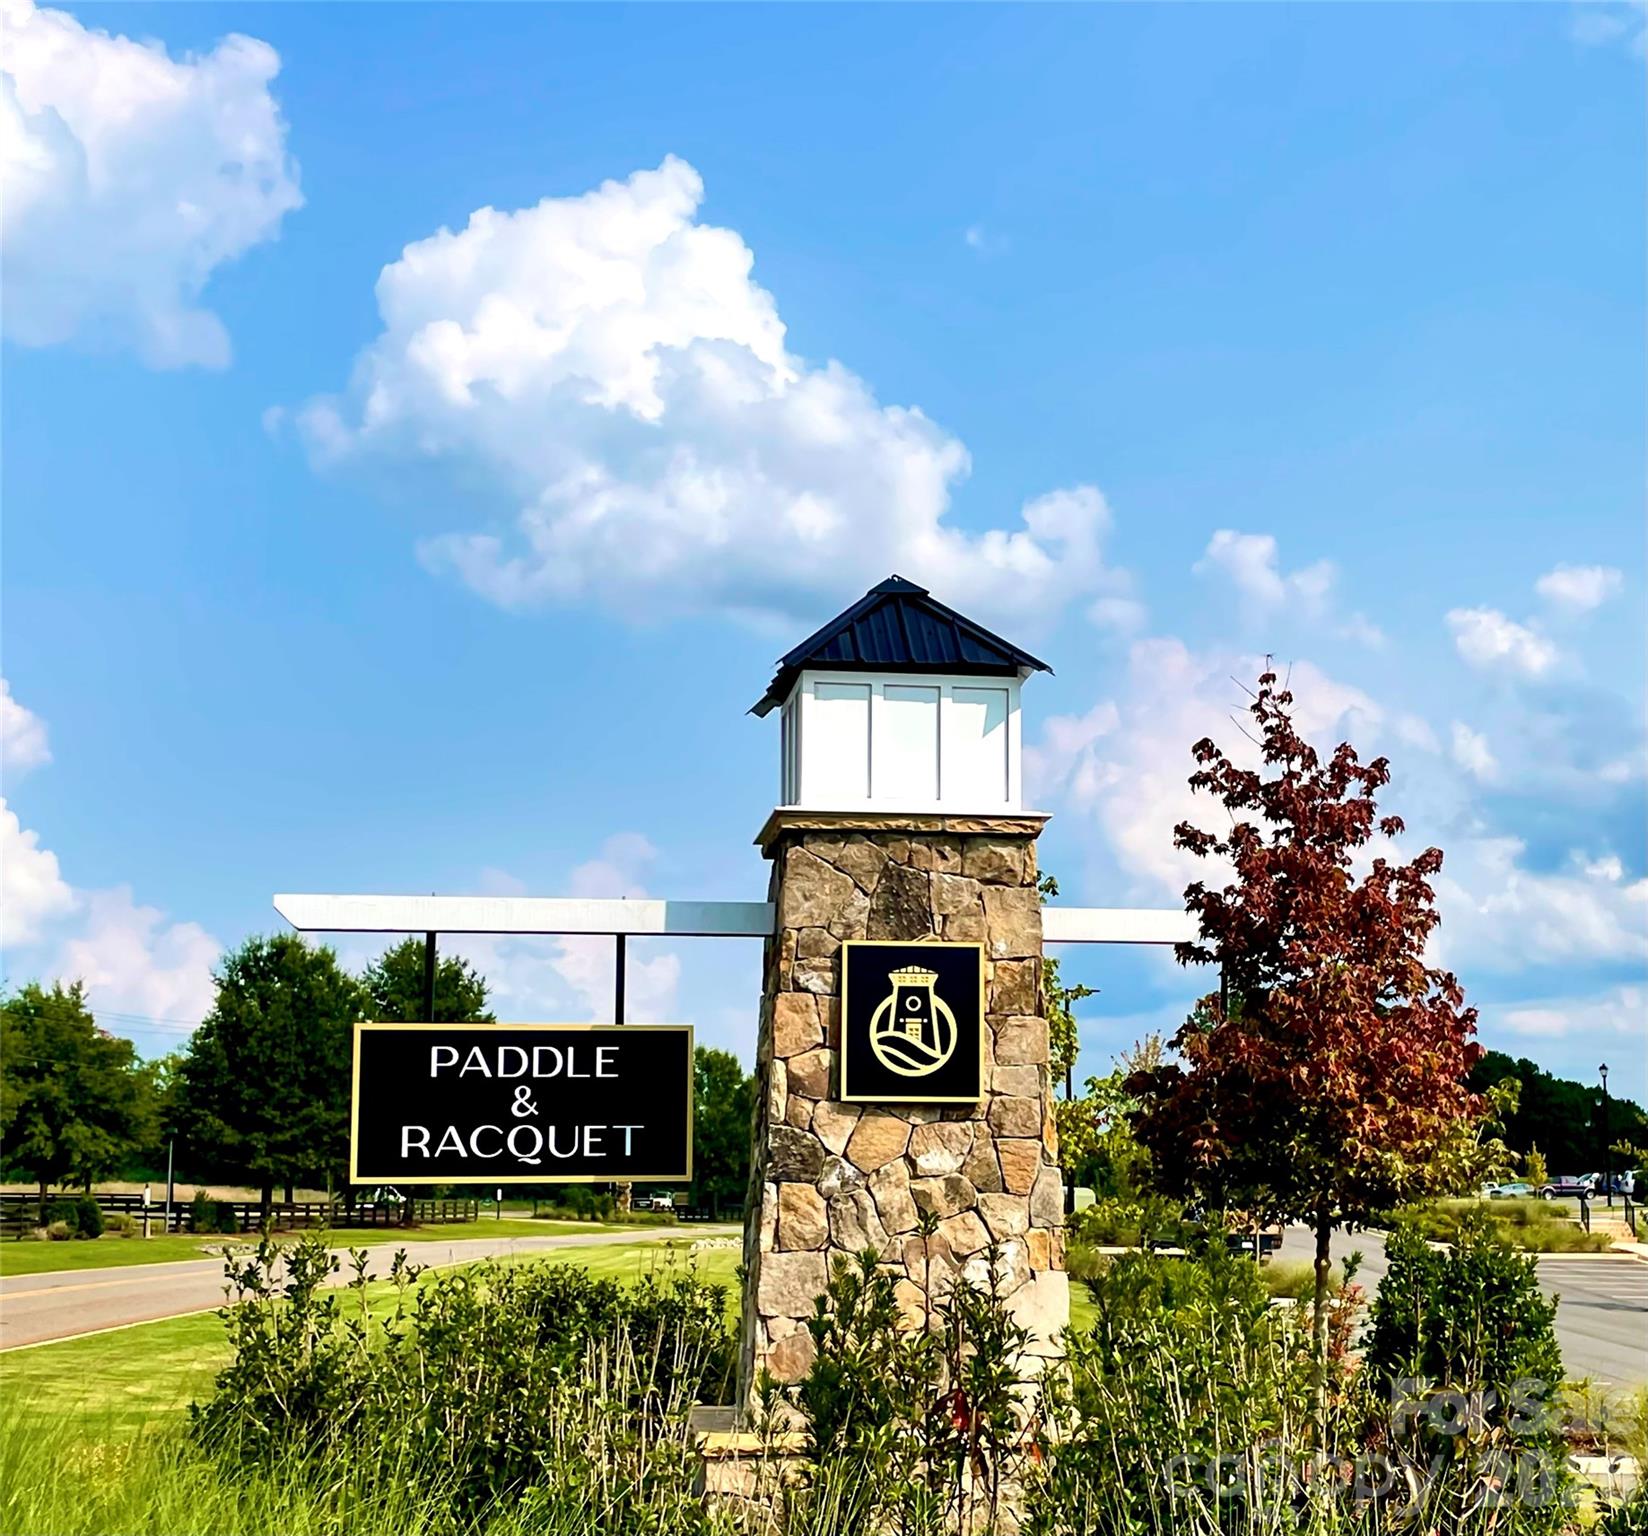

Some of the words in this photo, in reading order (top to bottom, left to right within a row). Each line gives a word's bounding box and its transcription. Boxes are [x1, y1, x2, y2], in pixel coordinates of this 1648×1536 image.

[430, 1045, 620, 1078] PADDLE
[510, 1085, 539, 1118] &
[400, 1124, 645, 1165] RACQUET
